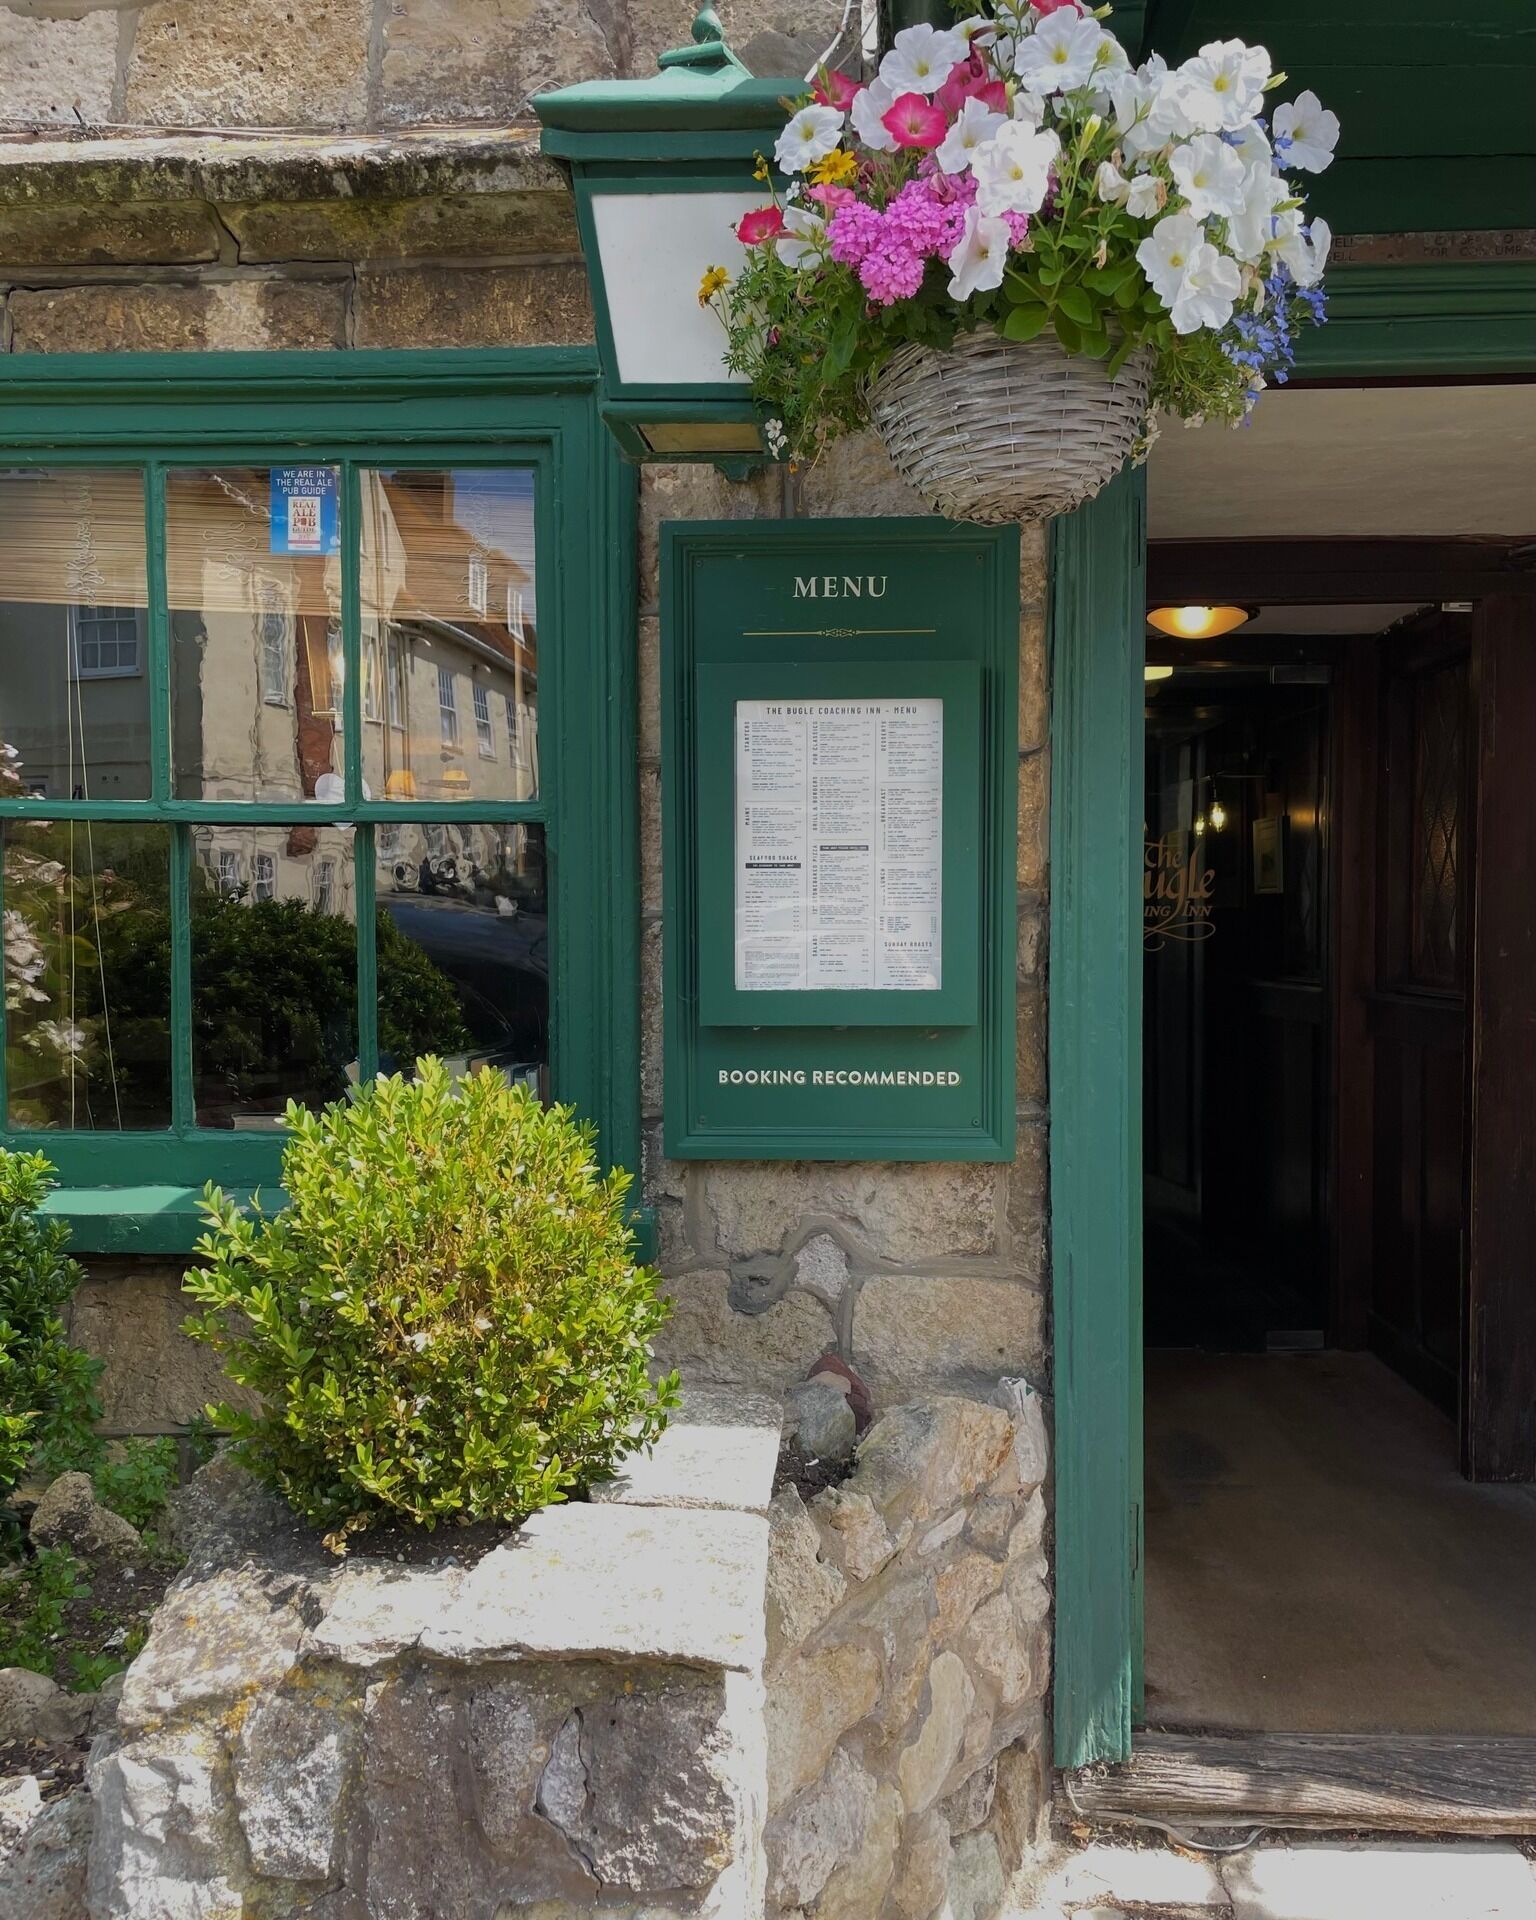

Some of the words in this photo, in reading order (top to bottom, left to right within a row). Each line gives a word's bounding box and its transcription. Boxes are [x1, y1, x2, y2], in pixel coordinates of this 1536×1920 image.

[282, 470, 296, 478] WE
[297, 470, 313, 478] ARE
[316, 470, 326, 478] IN
[276, 479, 292, 487] THE
[294, 479, 315, 487] REAL
[316, 478, 333, 487] ALE
[282, 487, 299, 495] PUB
[301, 487, 326, 495] GUIDE
[293, 509, 316, 517] ALE
[792, 576, 888, 598] MENU
[767, 707, 783, 715] THE
[786, 707, 815, 715] BUGLE
[865, 706, 881, 714] INN
[894, 706, 918, 714] MENU
[718, 1070, 806, 1085] BOOKING
[812, 1070, 960, 1086] RECOMMENDED
